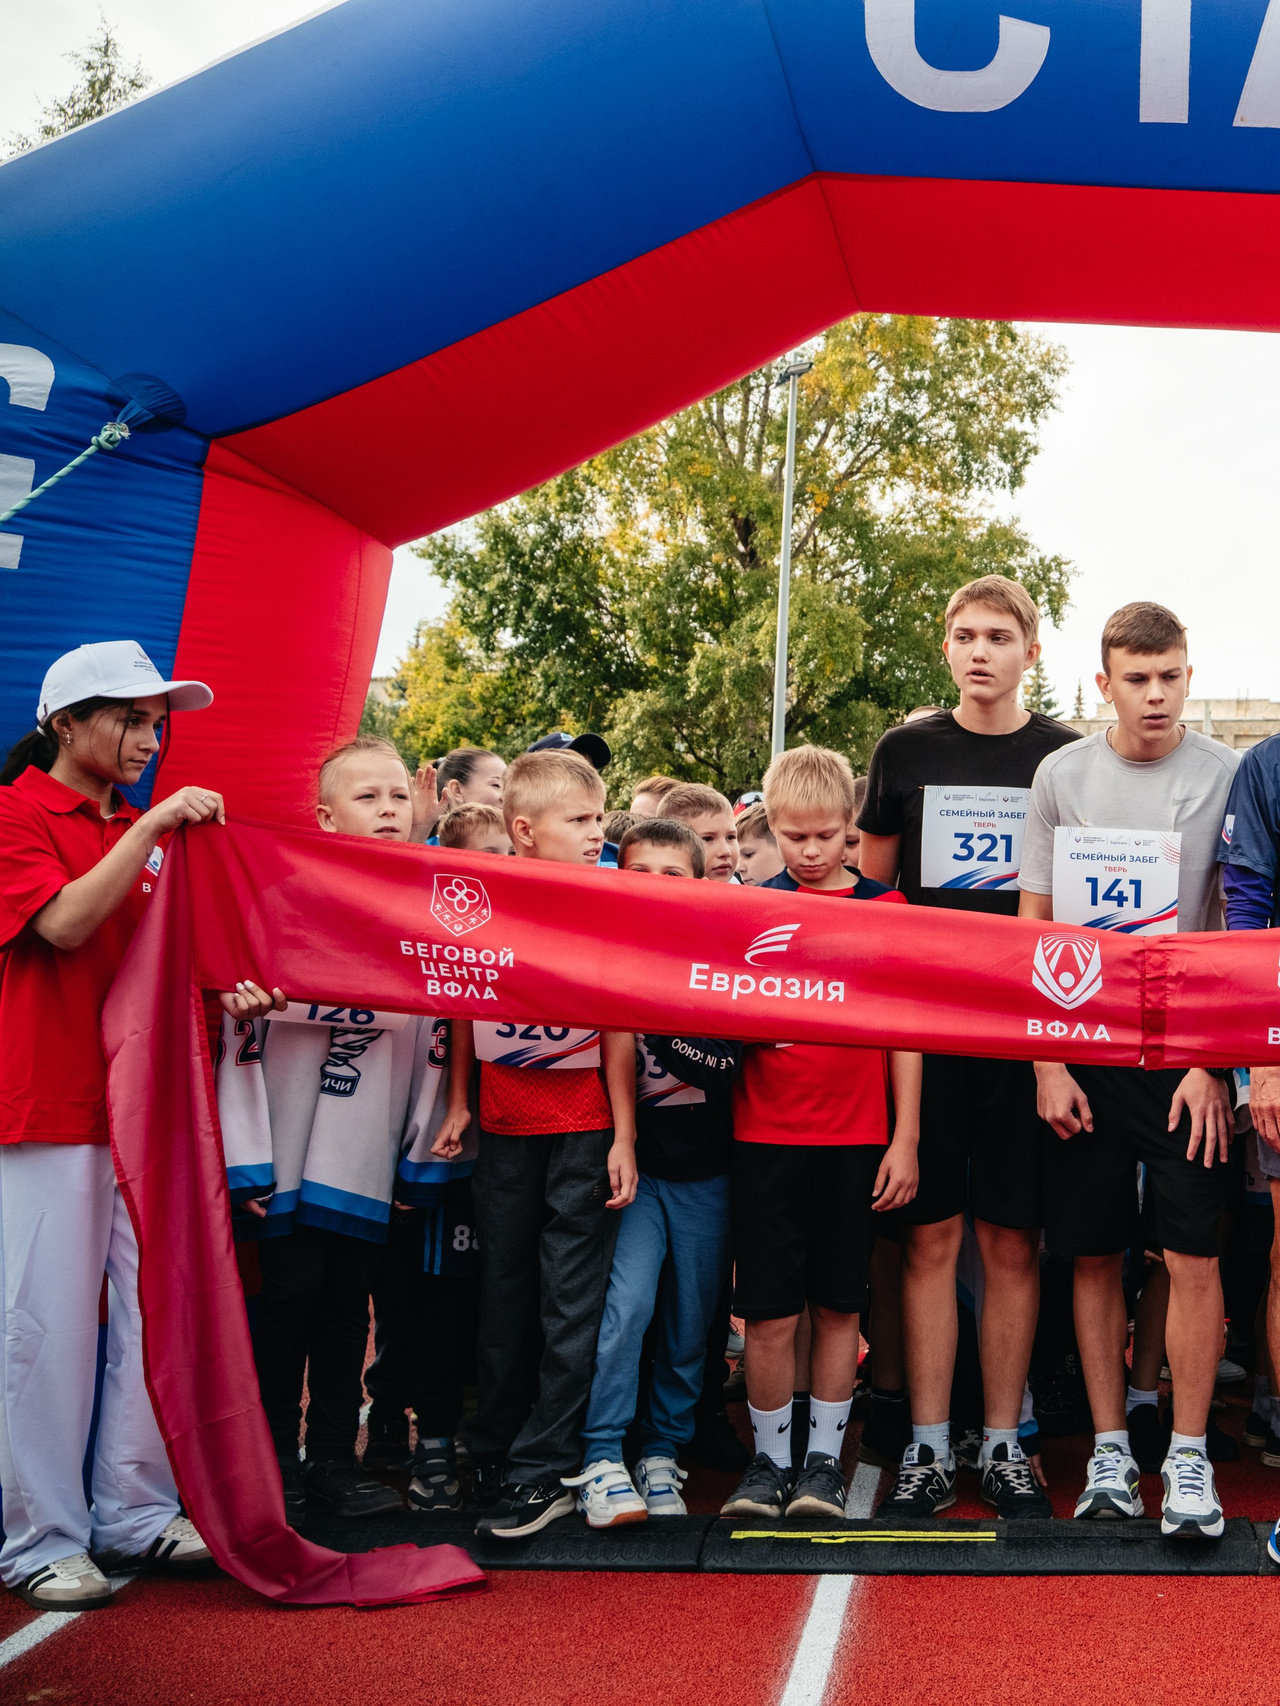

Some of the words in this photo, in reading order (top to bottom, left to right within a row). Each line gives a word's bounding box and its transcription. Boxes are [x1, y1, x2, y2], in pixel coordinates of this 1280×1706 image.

[939, 808, 996, 819] СЕМЕЙНЫЙ
[997, 811, 1027, 820] ЗАБЕГ
[972, 821, 997, 829] ТВЕРЬ
[952, 832, 1013, 863] 321
[1069, 851, 1127, 862] СЕМЕЙНЫЙ
[1128, 854, 1160, 864] ЗАБЕГ
[1103, 865, 1128, 873] ТВЕРЬ
[1085, 876, 1142, 909] 141
[400, 940, 515, 968] БЕГОВОЙ
[420, 960, 499, 983] ЦЕНТР
[688, 962, 845, 1002] Евразия
[426, 979, 499, 1001] ВФЛА
[1026, 1018, 1112, 1042] ВФЛА
[704, 1053, 718, 1068] IN
